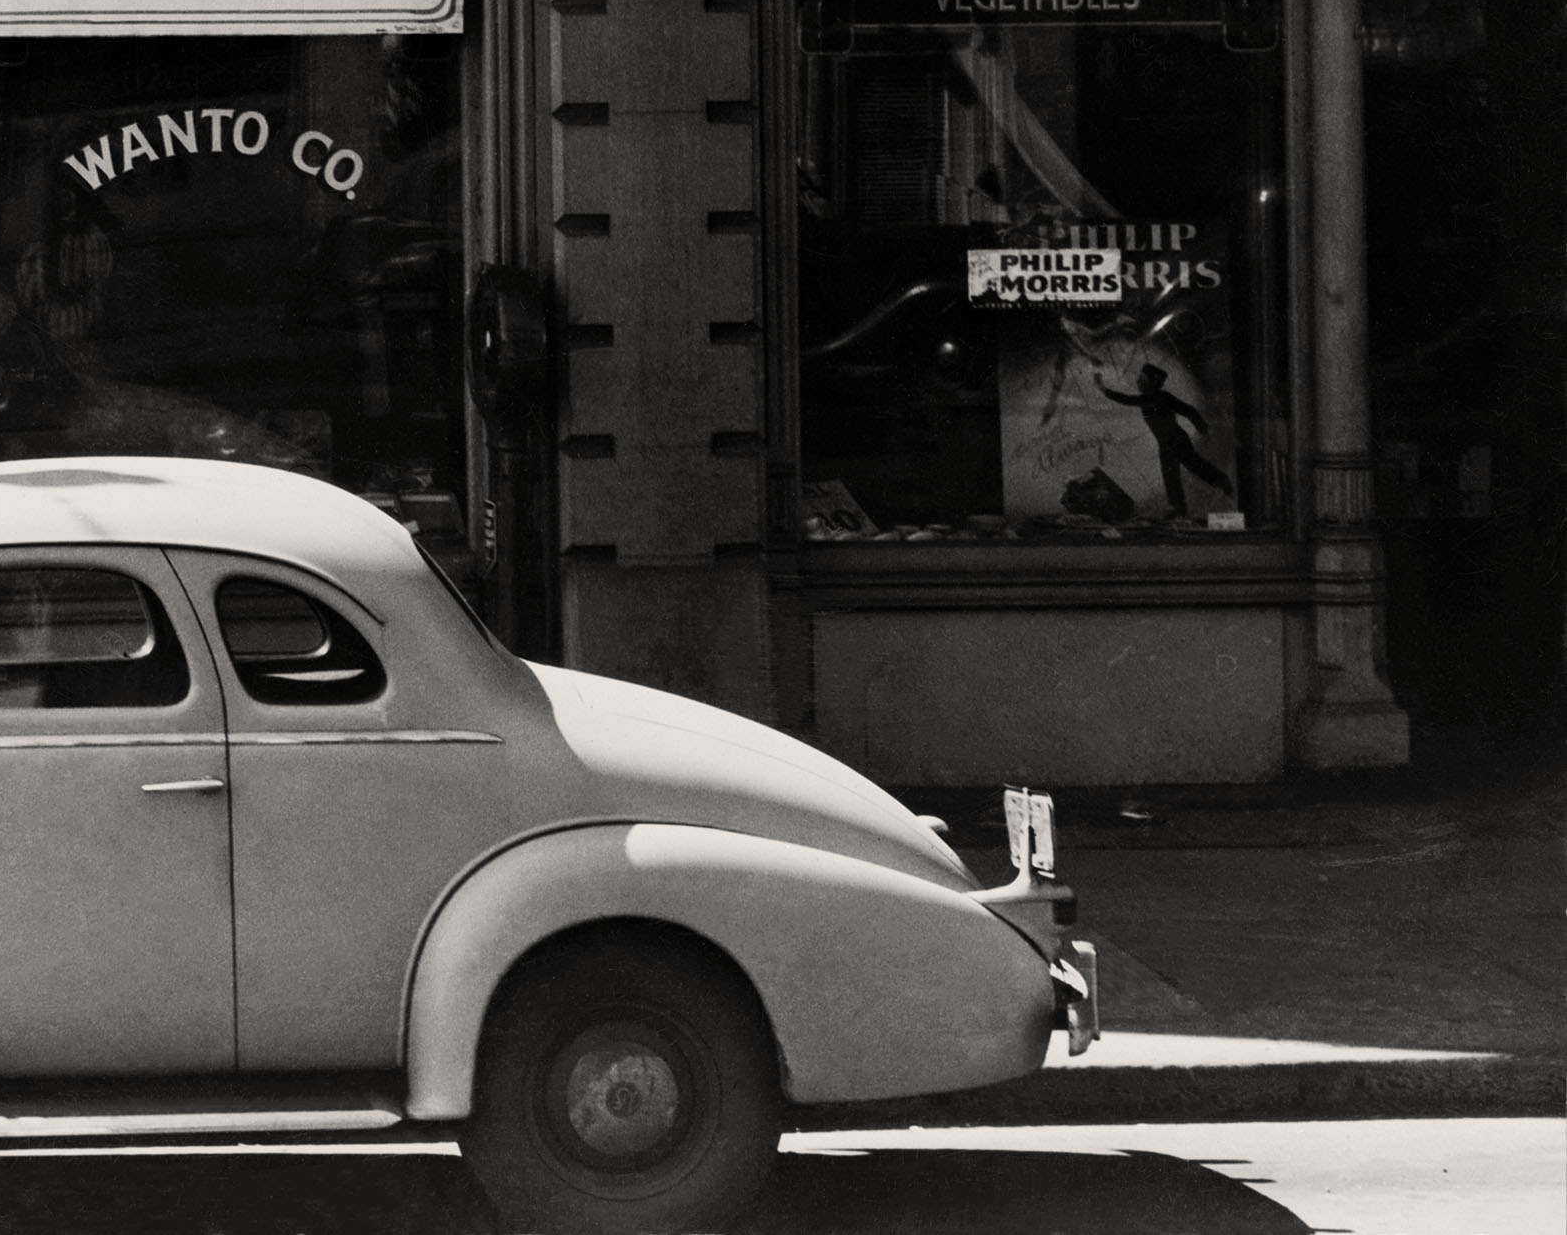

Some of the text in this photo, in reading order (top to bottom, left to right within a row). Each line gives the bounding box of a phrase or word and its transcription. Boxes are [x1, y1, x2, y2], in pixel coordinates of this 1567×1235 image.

[63, 108, 365, 201] WANTO CO.
[1000, 254, 1104, 272] PHILIP
[1000, 274, 1119, 294] MORRIS
